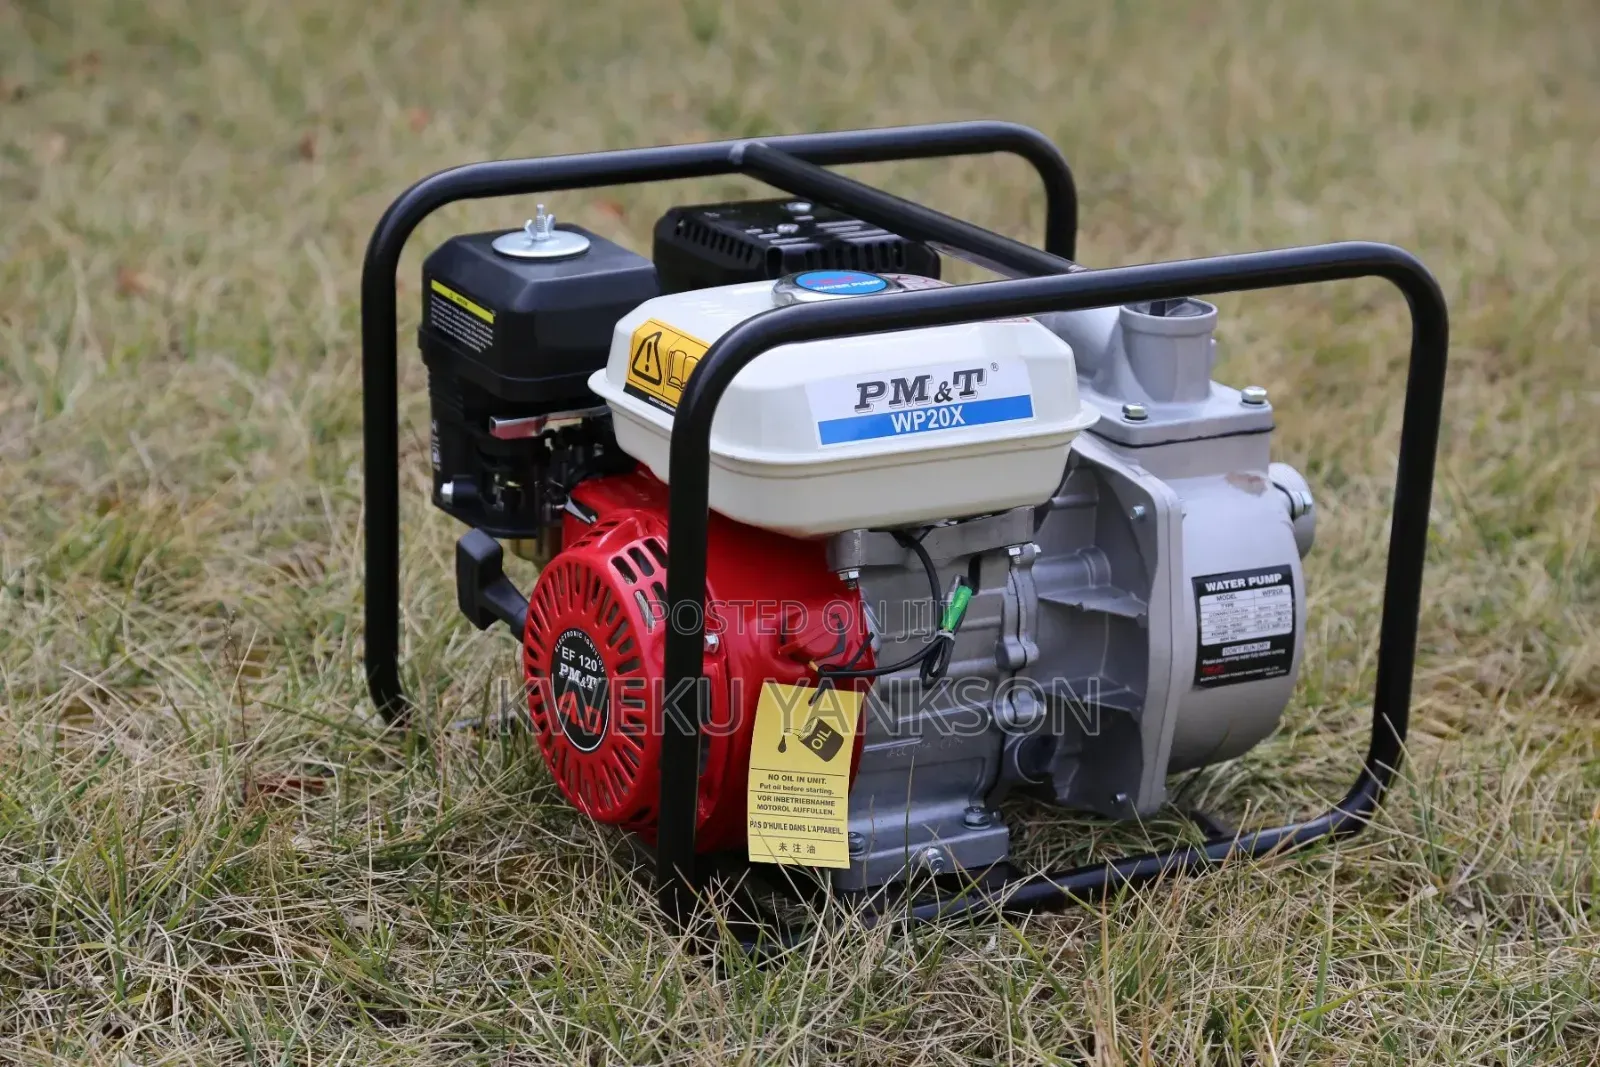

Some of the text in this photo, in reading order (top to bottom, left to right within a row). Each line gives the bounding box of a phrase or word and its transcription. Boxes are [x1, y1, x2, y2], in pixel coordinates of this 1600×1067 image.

[891, 405, 966, 433] WP20X
[1205, 573, 1282, 592] WATER PUMP
[1216, 593, 1237, 601] MODEL
[562, 646, 598, 672] EF 120
[559, 663, 598, 692] PM&T
[811, 730, 832, 750] OIL
[806, 787, 834, 795] starting.
[773, 796, 836, 807] INBETRIEBNAHME
[750, 821, 762, 829] PAS
[763, 822, 787, 831] D'HUILE
[807, 825, 844, 835] L'APPAREIL.
